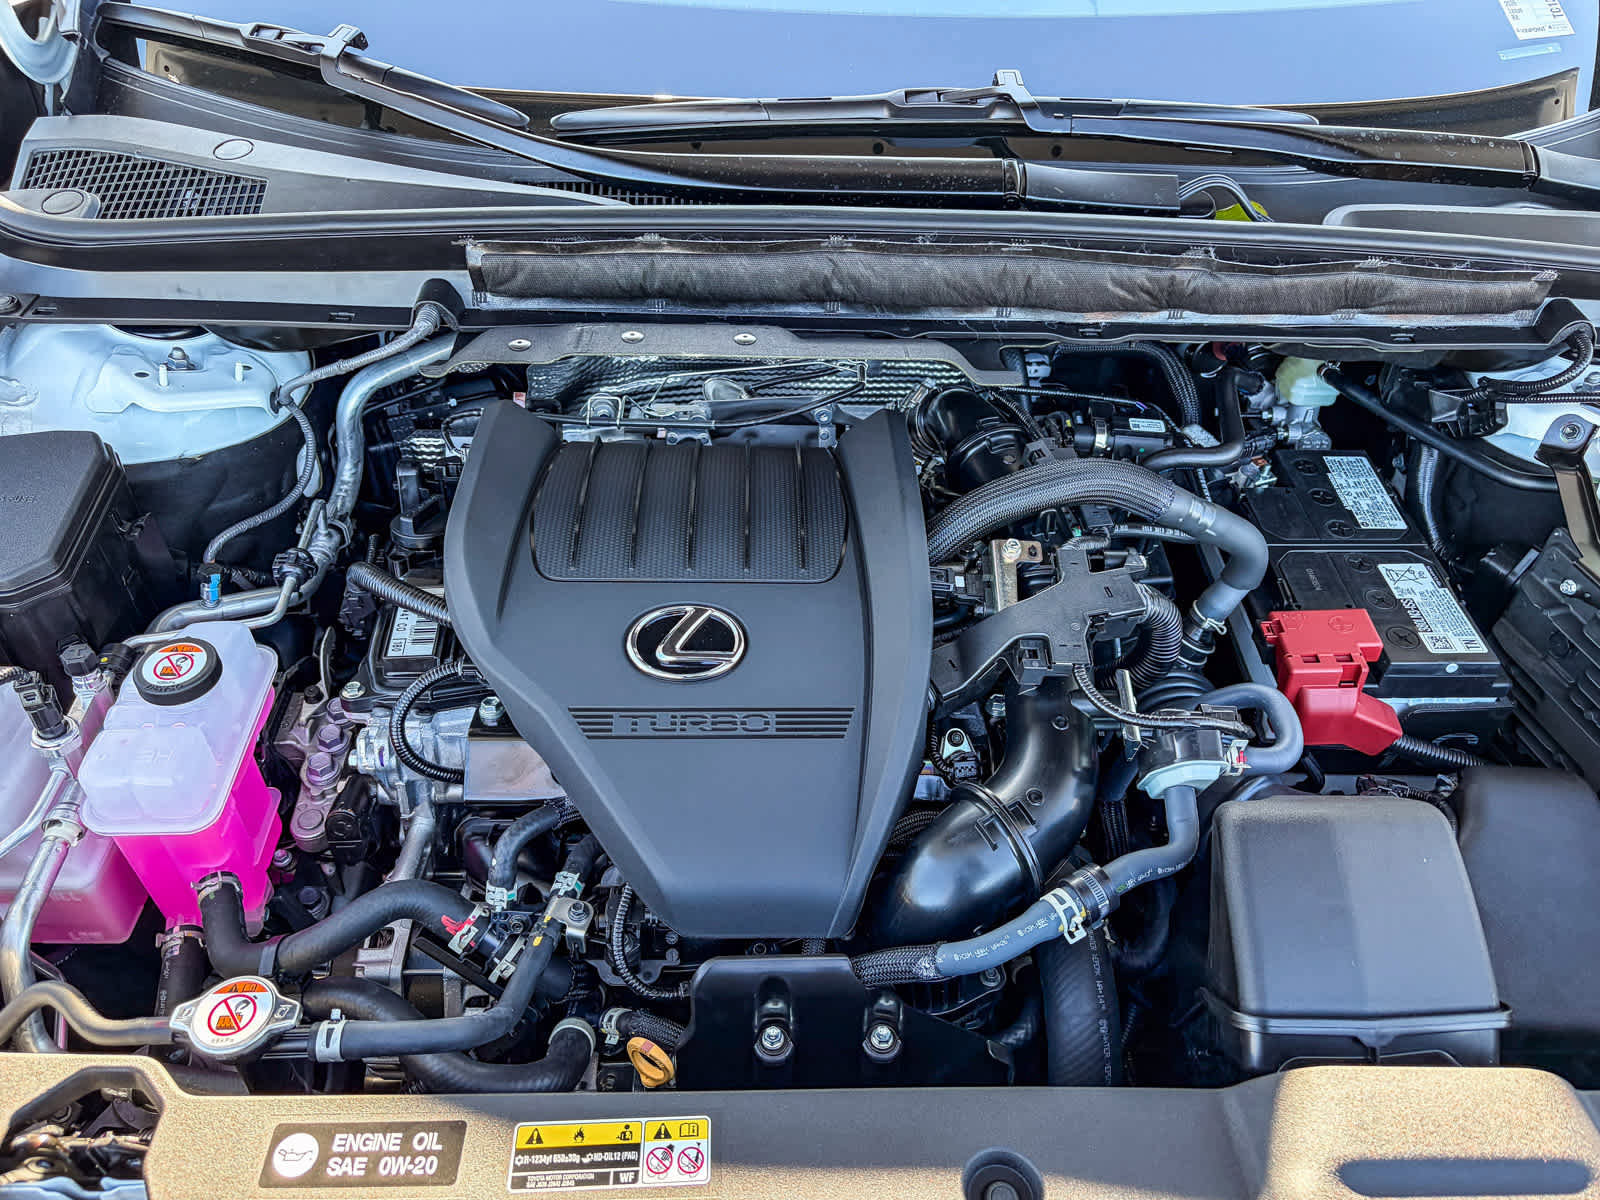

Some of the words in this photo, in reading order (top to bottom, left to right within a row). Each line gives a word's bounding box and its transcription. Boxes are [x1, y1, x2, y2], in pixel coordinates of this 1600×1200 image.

[617, 713, 771, 733] TURBO
[331, 1132, 403, 1153] ENGINE
[412, 1131, 444, 1151] OIL
[325, 1156, 369, 1177] SAE
[378, 1155, 439, 1176] 0W-20
[619, 1172, 635, 1184] WF
